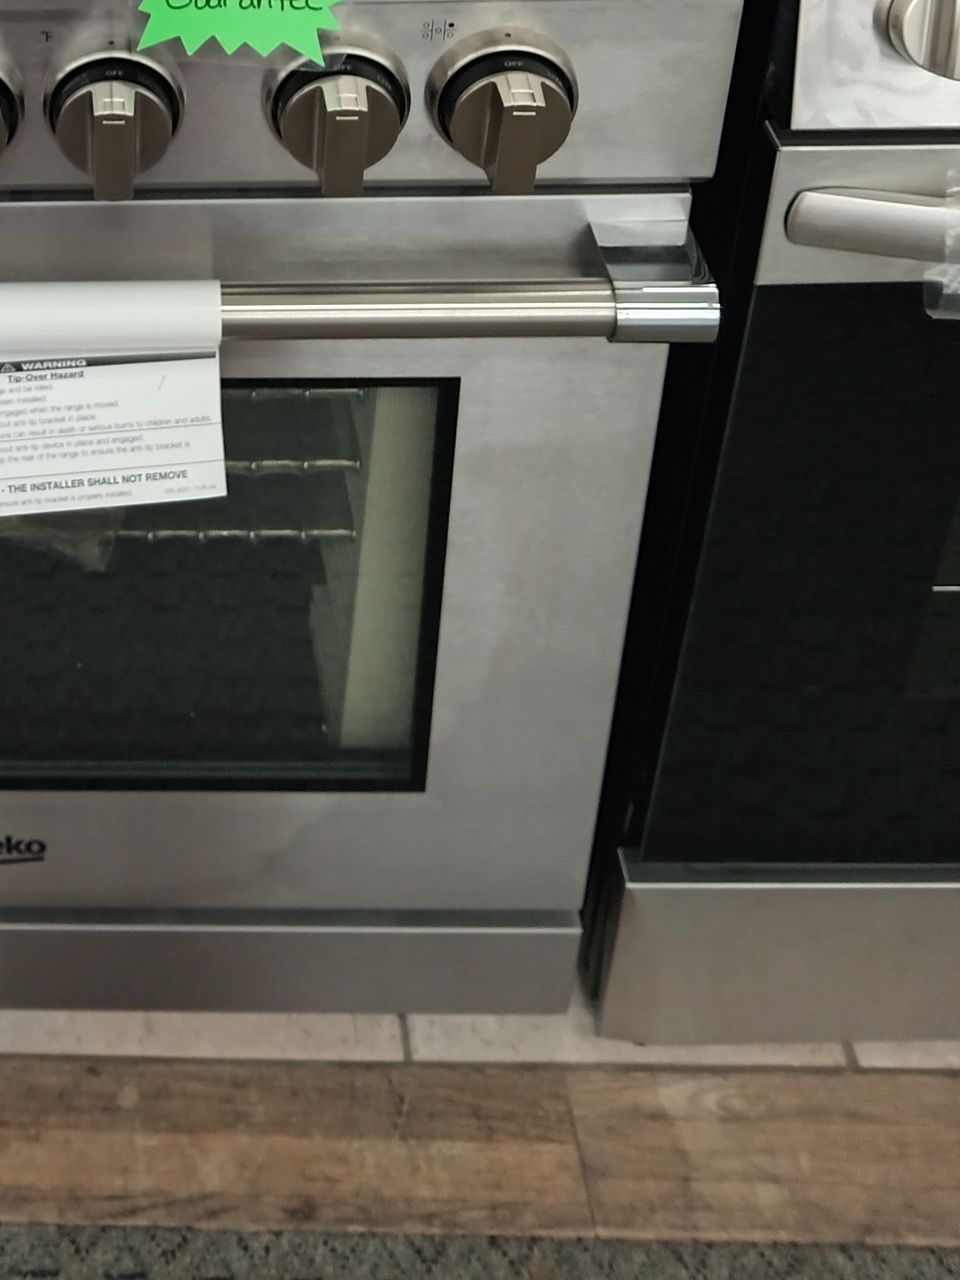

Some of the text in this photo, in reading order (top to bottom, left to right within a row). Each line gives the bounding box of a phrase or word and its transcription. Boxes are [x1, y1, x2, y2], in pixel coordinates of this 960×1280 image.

[21, 358, 87, 370] WARNING
[8, 370, 84, 383] Tip-Over Hazard
[7, 483, 27, 493] THE
[30, 478, 84, 491] INSTALLER
[86, 475, 118, 487] SHALL
[121, 473, 142, 484] NOT
[145, 469, 188, 482] REMOVE
